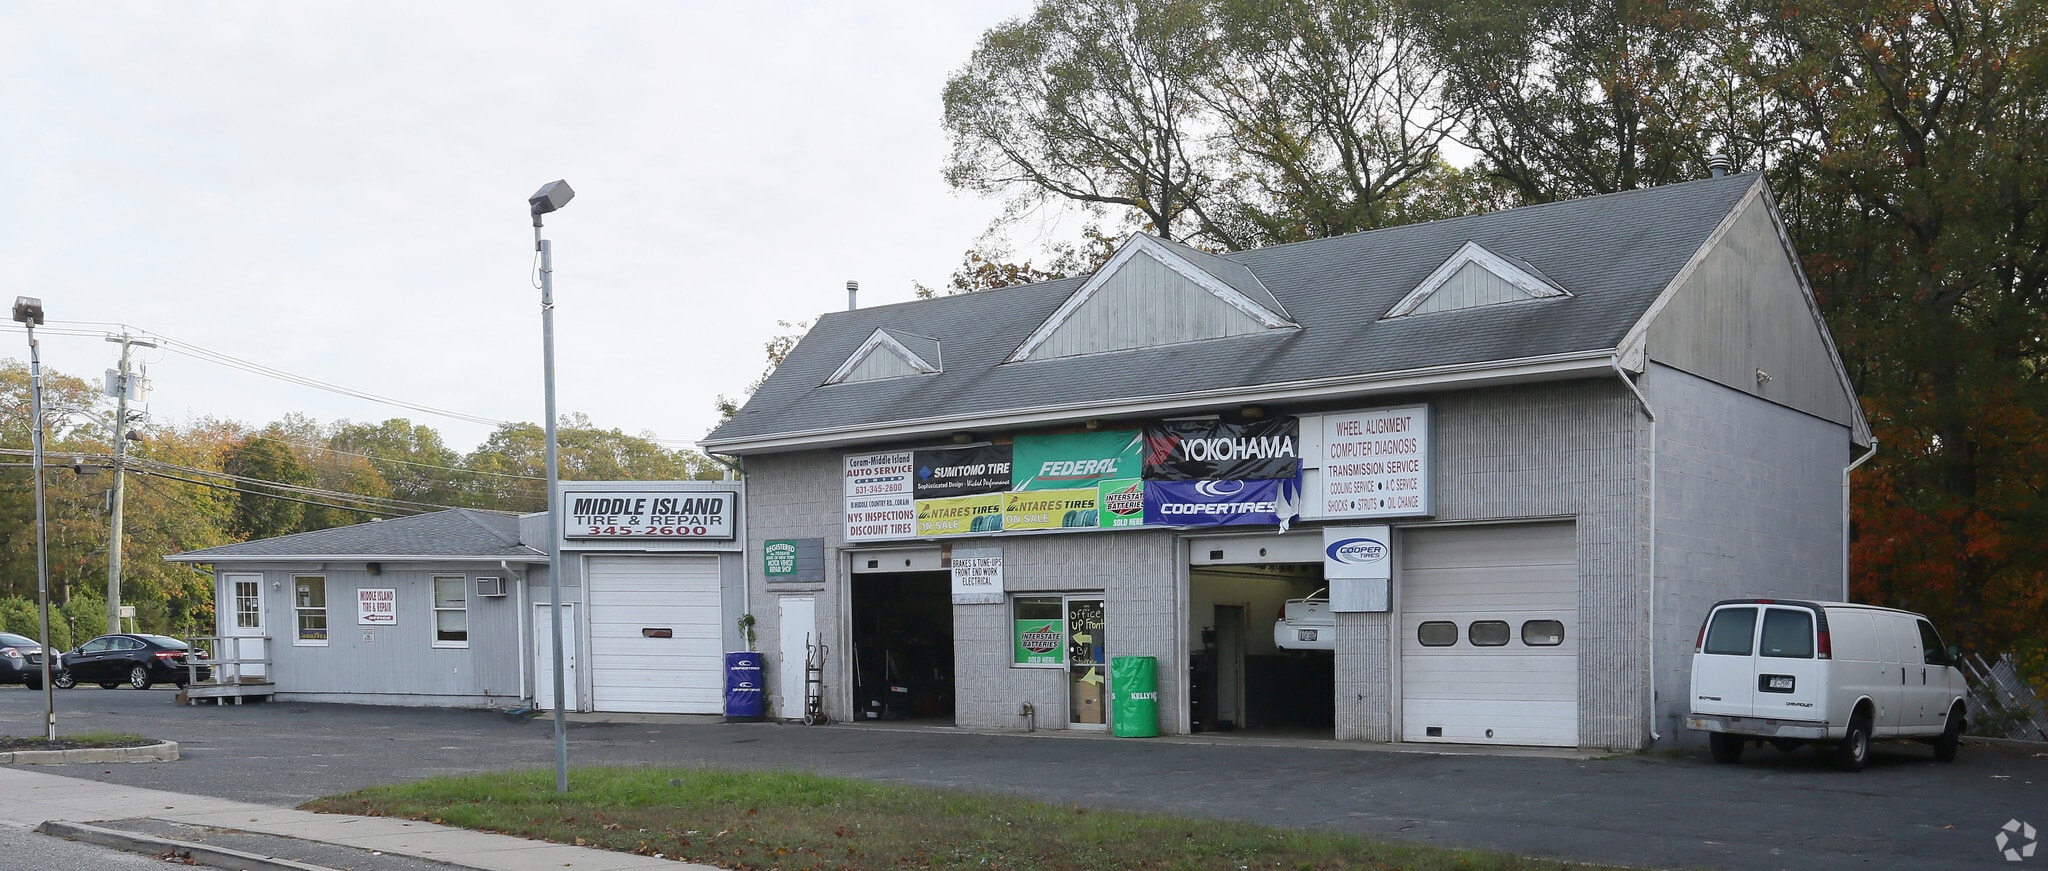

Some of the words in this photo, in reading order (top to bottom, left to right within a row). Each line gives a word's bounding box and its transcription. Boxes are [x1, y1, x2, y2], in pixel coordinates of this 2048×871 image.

[1336, 420, 1362, 436] WHEEL
[1366, 416, 1411, 434] ALIGNMENT
[1180, 435, 1295, 462] YOKOHAMA
[1331, 441, 1372, 458] COMPUTER
[1374, 437, 1417, 455] DIAGNOSIS
[849, 455, 891, 468] Coram-Middle
[892, 453, 911, 465] Island
[846, 467, 872, 478] AUTO
[874, 464, 913, 476] SERVICE
[933, 463, 986, 479] SUMITOMO
[987, 462, 1011, 475] TIRE
[1038, 458, 1119, 476] FEDERAL
[1328, 462, 1384, 477] TRANSMISSION
[1386, 459, 1419, 474] SERVICE
[855, 483, 903, 495] 631-345-2600
[917, 482, 948, 490] Sophisticated
[948, 481, 964, 489] Design
[1330, 482, 1353, 495] COOLING
[1353, 480, 1375, 494] SERVICE
[1396, 477, 1418, 491] SERVICE
[1106, 493, 1144, 502] INTERSTAT
[573, 498, 646, 515] MIDDLE
[651, 498, 723, 515] ISLAND
[854, 501, 869, 509] MIDDLE
[868, 499, 886, 508] COUNTRY
[1065, 499, 1095, 509] TIRES
[1107, 501, 1144, 510] BATTERIES
[1161, 502, 1277, 515] COOPERTIRES
[1328, 499, 1348, 512] SHOCKS
[1357, 497, 1377, 511] STRUTS
[1387, 496, 1396, 509] OIL
[1397, 495, 1419, 509] CHANGE
[972, 504, 1000, 515] TIRES
[574, 515, 618, 526] TIRE
[628, 515, 641, 526] &
[650, 515, 723, 526] REPAIR
[847, 512, 863, 523] NYS
[864, 510, 914, 522] INSPECTIONS
[1006, 514, 1020, 525] ON
[1023, 512, 1049, 524] SALE
[1113, 518, 1128, 527] SOLD
[1129, 517, 1143, 526] HERE
[850, 523, 888, 536] DISCOUNT
[890, 523, 912, 535] TIRES
[919, 522, 933, 531] ON
[936, 519, 959, 530] SALE
[588, 526, 707, 536] 345-2600
[766, 543, 795, 554] REGISTERED
[1340, 546, 1381, 554] COOPER
[780, 559, 794, 567] VEHICLE
[953, 559, 971, 568] BRAKES
[973, 558, 977, 567] &
[977, 557, 1002, 567] TUNE-UPS
[781, 565, 792, 573] SHOP
[955, 568, 971, 577] FRONT
[972, 567, 982, 576] END
[983, 567, 998, 576] WORK
[962, 576, 992, 586] ELECTRICAL
[360, 591, 377, 601] MIDDLE
[377, 591, 393, 601] ISLAND
[362, 602, 372, 612] TIRE
[372, 602, 376, 612] &
[377, 602, 392, 612] REPAIR
[1028, 656, 1042, 664] SOLD
[1042, 656, 1056, 664] HERE
